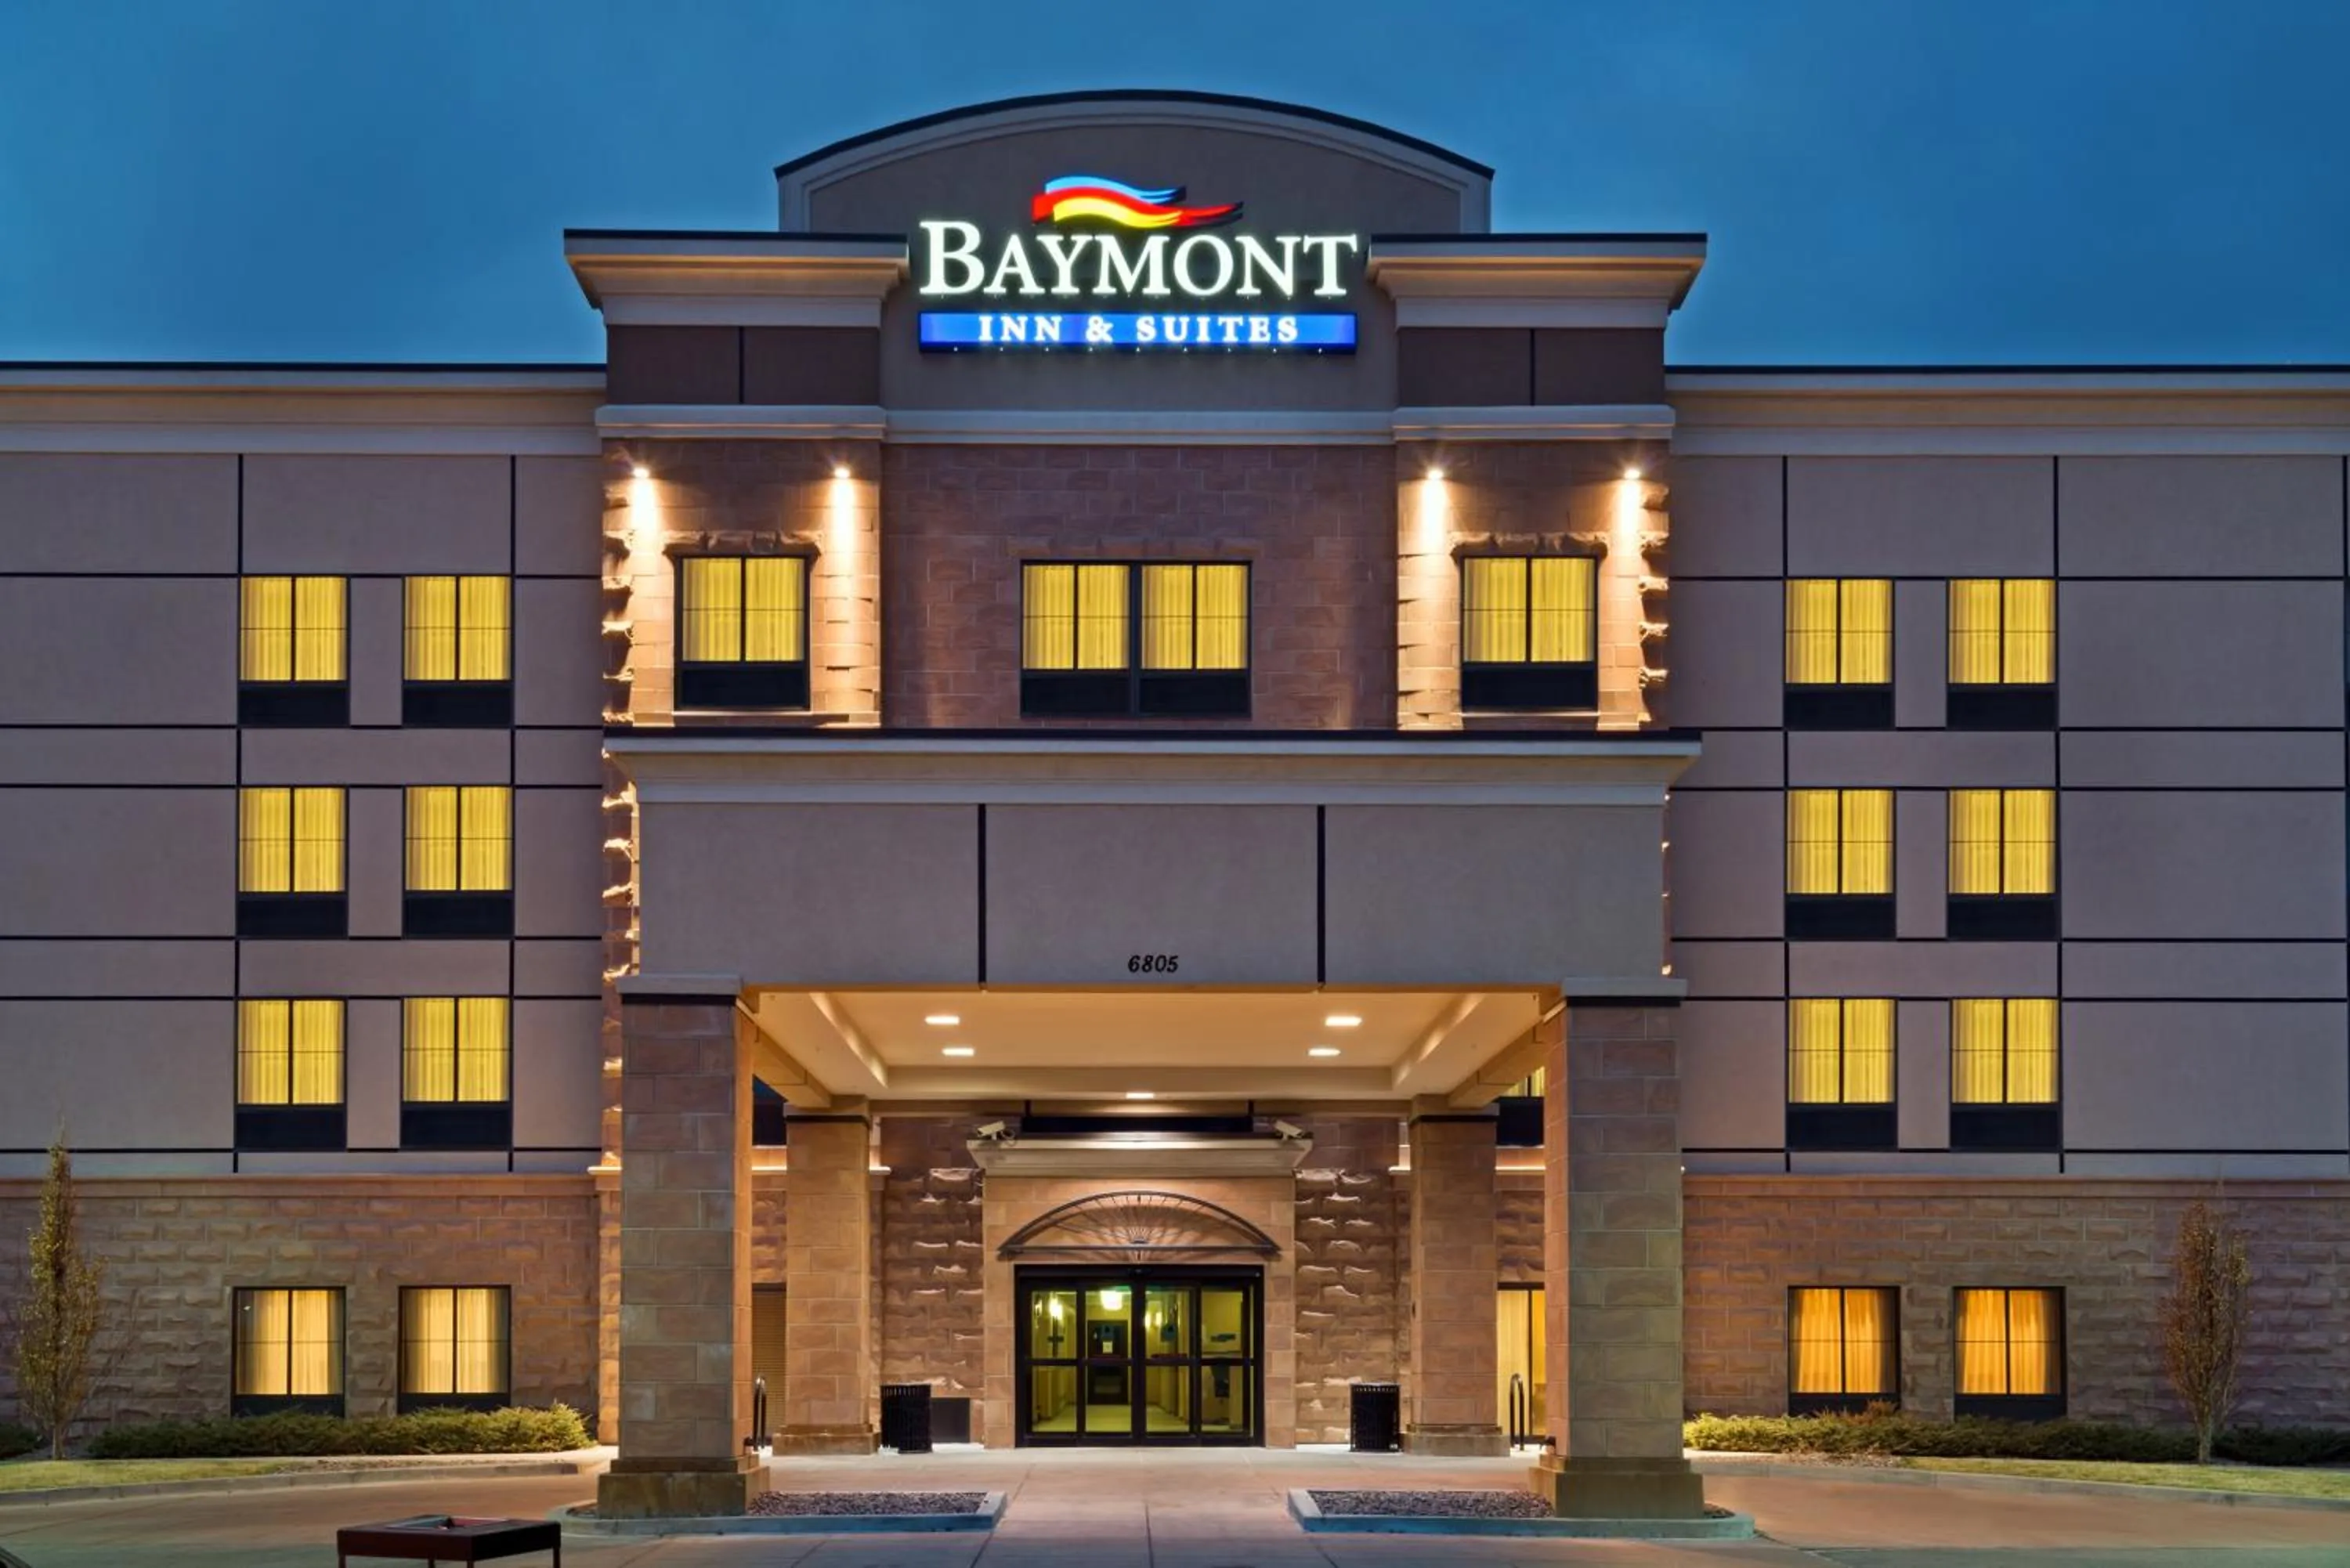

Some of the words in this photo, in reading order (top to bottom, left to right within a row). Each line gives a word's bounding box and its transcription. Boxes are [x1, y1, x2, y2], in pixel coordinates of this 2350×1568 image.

[919, 220, 1358, 295] BAYMONT
[978, 315, 1063, 343] INN
[1085, 315, 1113, 343] &
[1136, 315, 1300, 343] SUITES
[1128, 955, 1178, 973] 6805
